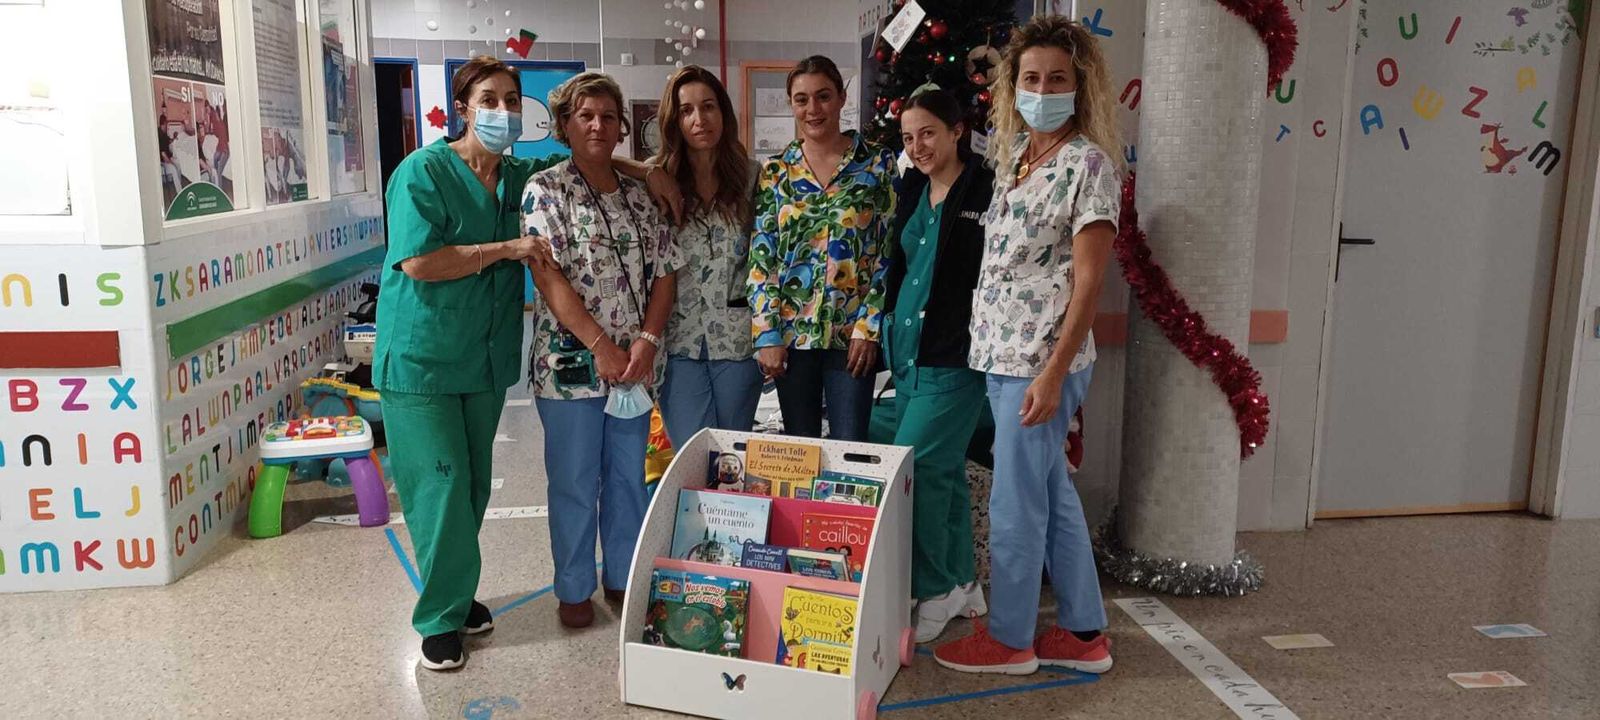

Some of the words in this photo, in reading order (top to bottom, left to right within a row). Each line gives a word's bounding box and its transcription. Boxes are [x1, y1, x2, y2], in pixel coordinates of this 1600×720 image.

[1398, 13, 1418, 40] U
[1360, 104, 1384, 135] A
[697, 502, 748, 518] Cuéntame
[722, 519, 754, 529] cuento
[746, 560, 782, 571] DETECTIVES
